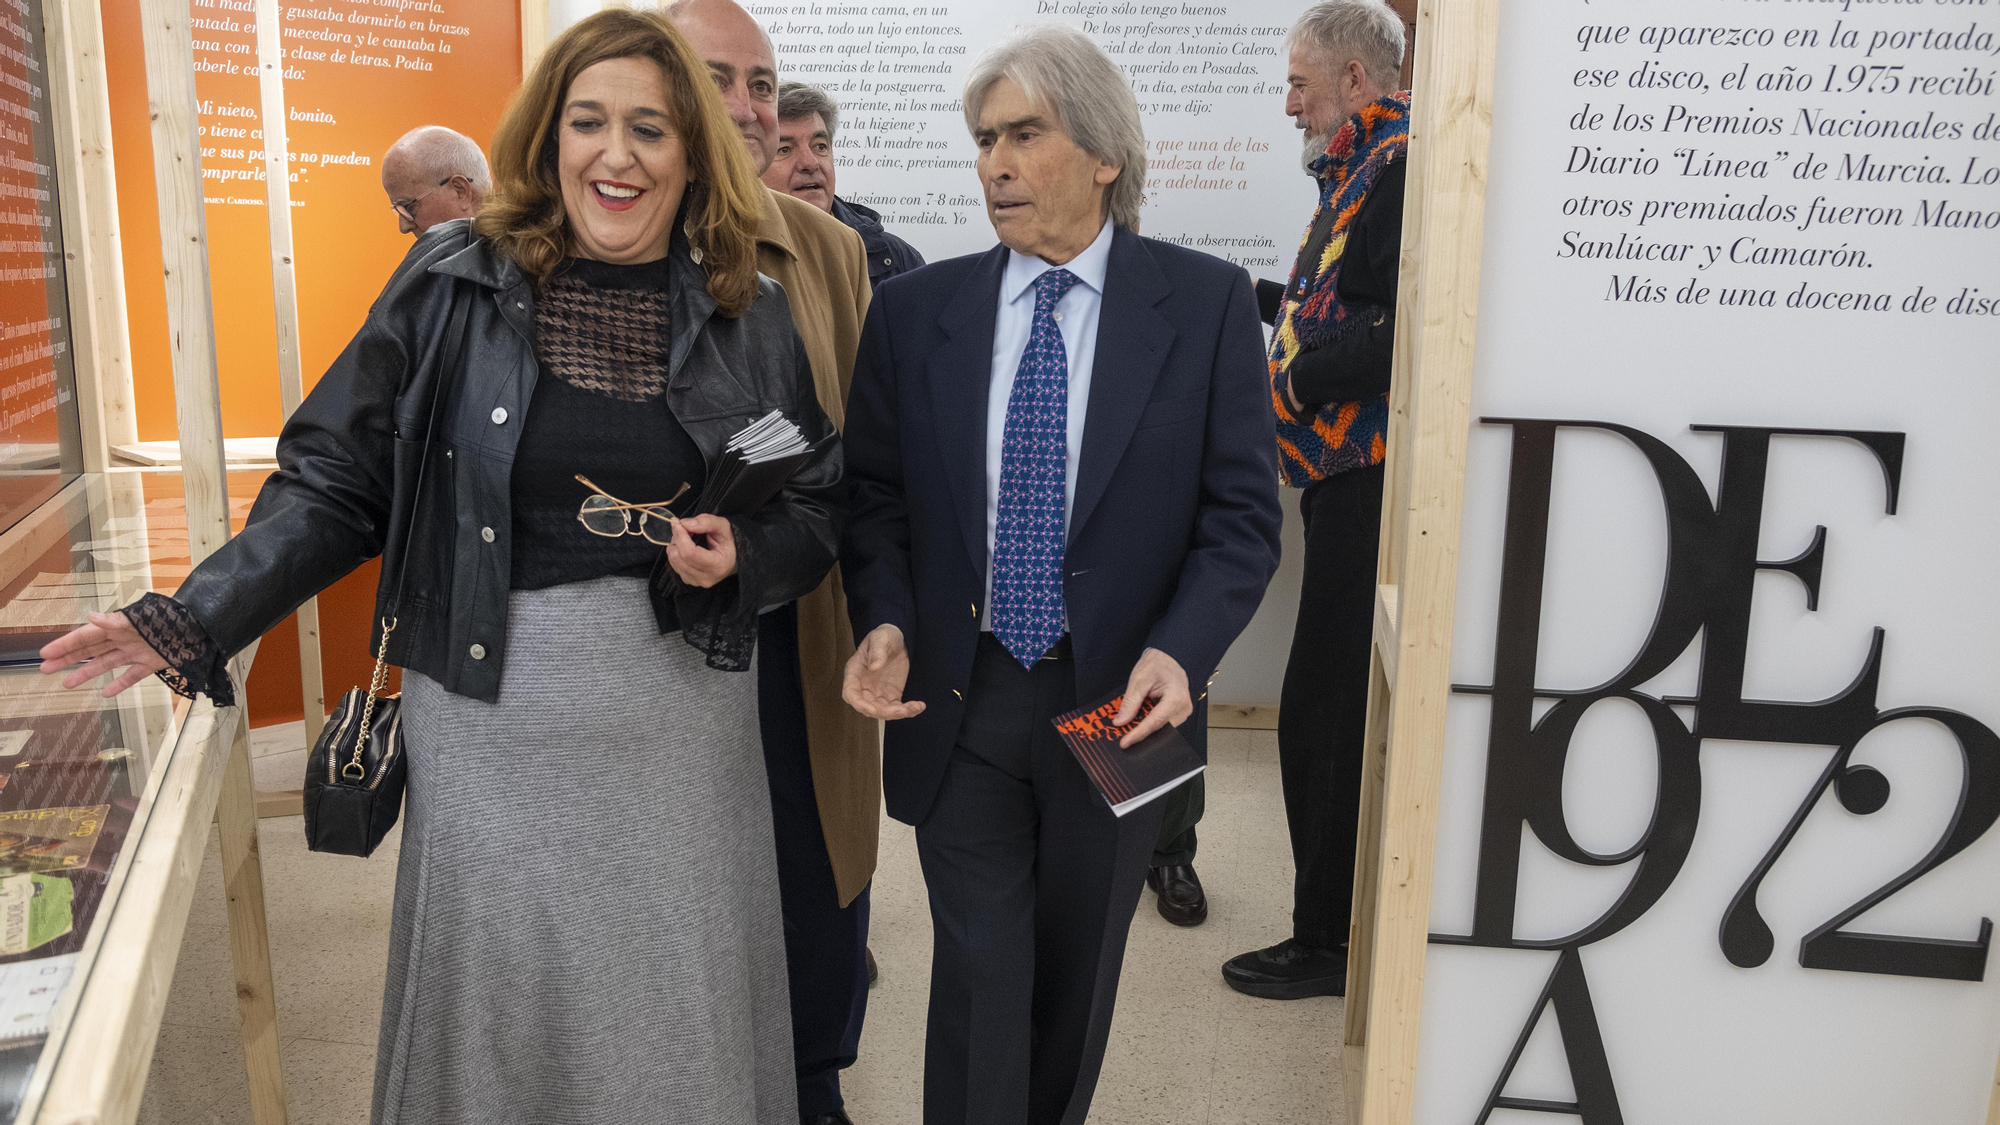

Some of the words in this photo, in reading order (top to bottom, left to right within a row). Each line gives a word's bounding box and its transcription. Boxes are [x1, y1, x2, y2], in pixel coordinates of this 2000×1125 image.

[792, 6, 805, 16] en
[810, 3, 822, 16] la
[826, 4, 868, 16] misma
[872, 6, 909, 18] cama,
[912, 6, 928, 16] en
[932, 7, 948, 16] un
[1038, 1, 1059, 14] Del
[1062, 2, 1108, 18] colegio
[1112, 2, 1136, 15] sólo
[1140, 4, 1177, 18] tengo
[1181, 3, 1226, 16] buenos
[286, 7, 344, 22] gustaba
[348, 8, 406, 28] dormirlo
[410, 21, 424, 31] en
[429, 19, 470, 36] brazos
[768, 22, 783, 34] de
[786, 22, 824, 37] borra,
[828, 22, 854, 34] todo
[858, 26, 874, 34] un
[878, 22, 902, 38] lujo
[905, 24, 962, 36] entonces.
[1084, 21, 1100, 34] De
[1103, 22, 1120, 34] los
[1124, 22, 1190, 38] profesores
[1192, 26, 1202, 38] y
[1205, 22, 1248, 36] demás
[1251, 26, 1288, 36] curas
[191, 17, 240, 32] entada
[284, 28, 351, 43] mecedora
[354, 35, 364, 48] y
[368, 32, 379, 46] le
[383, 38, 435, 52] cantaba
[438, 40, 452, 54] la
[1577, 26, 1630, 52] que
[1640, 26, 1774, 53] aparezco
[1784, 29, 1818, 48] en
[1830, 20, 1859, 48] la
[192, 40, 220, 51] ana
[225, 43, 250, 54] con
[291, 46, 326, 61] clase
[330, 49, 346, 63] de
[350, 51, 392, 68] letras.
[395, 55, 432, 72] Podía
[778, 44, 816, 54] tantas
[820, 44, 834, 54] en
[838, 41, 872, 57] aquel
[874, 41, 918, 58] tiempo,
[923, 42, 934, 54] la
[938, 46, 966, 54] casa
[1128, 41, 1144, 54] de
[1148, 41, 1171, 54] don
[1175, 42, 1228, 55] Antonio
[1232, 42, 1277, 56] Calero,
[194, 58, 239, 74] aberle
[779, 60, 796, 72] las
[800, 60, 857, 73] carencias
[860, 60, 874, 73] de
[878, 60, 890, 74] la
[894, 60, 952, 74] tremenda
[1130, 60, 1178, 76] querido
[1182, 65, 1198, 74] en
[1202, 61, 1258, 74] Posadas.
[1132, 80, 1148, 92] Un
[1152, 80, 1176, 94] día,
[1180, 80, 1222, 94] estaba
[1226, 83, 1249, 94] con
[1253, 82, 1265, 94] él
[1268, 85, 1283, 94] en
[1574, 69, 1618, 88] ese
[1628, 61, 1710, 94] disco,
[1720, 63, 1748, 91] el
[1756, 66, 1812, 92] año
[1820, 64, 1904, 94] 1.975
[1909, 68, 1996, 96] recibí
[842, 79, 856, 92] de
[860, 79, 872, 92] la
[874, 82, 946, 96] postguerra.
[218, 102, 258, 119] nieto,
[290, 107, 336, 126] bonito,
[840, 98, 891, 114] orriente,
[894, 99, 907, 112] ni
[910, 99, 927, 112] los
[1149, 103, 1159, 115] y
[1162, 103, 1181, 112] me
[1184, 100, 1212, 116] dijo:
[210, 123, 246, 138] tiene
[854, 117, 866, 130] la
[870, 117, 915, 134] higiene
[917, 122, 926, 134] y
[1570, 104, 1604, 131] de
[1613, 104, 1654, 132] los
[1662, 105, 1784, 136] Premios
[1790, 108, 1964, 140] Nacionales
[866, 136, 880, 148] Mi
[884, 136, 923, 149] madre
[926, 140, 948, 150] nos
[1156, 140, 1184, 154] que
[1188, 141, 1218, 152] una
[1224, 137, 1241, 152] de
[1246, 137, 1270, 152] las
[220, 148, 244, 159] sus
[300, 153, 318, 162] no
[321, 151, 370, 167] pueden
[857, 155, 872, 168] de
[876, 155, 904, 169] cinc,
[906, 156, 979, 171] previament
[1147, 155, 1203, 170] andeza
[1207, 156, 1225, 170] de
[1230, 156, 1245, 171] la
[1564, 146, 1658, 176] Diario
[1674, 148, 1788, 179] “Línea”
[1793, 152, 1828, 180] de
[1836, 153, 1950, 184] Murcia.
[1961, 157, 2000, 186] Lo
[1166, 174, 1233, 190] adelante
[1238, 181, 1247, 190] a
[900, 196, 921, 206] con
[926, 193, 946, 206] 7-8
[949, 195, 980, 206] años.
[898, 212, 947, 224] medida.
[954, 212, 966, 224] Yo
[1562, 196, 1632, 218] otros
[1639, 194, 1797, 226] premiados
[1798, 196, 1902, 231] fueron
[1912, 200, 2000, 229] Mano
[1196, 234, 1276, 248] observación.
[1557, 230, 1693, 262] Sanlúcar
[1698, 242, 1722, 270] y
[1730, 236, 1873, 268] Camarón.
[1241, 255, 1278, 268] pensé
[1604, 274, 1668, 304] Más
[1676, 278, 1710, 305] de
[1720, 285, 1778, 308] una
[1786, 282, 1892, 312] docena
[1902, 286, 1937, 314] de
[1946, 288, 2000, 316] disc
[1451, 416, 1906, 745] DE
[1427, 690, 2000, 982] 1972
